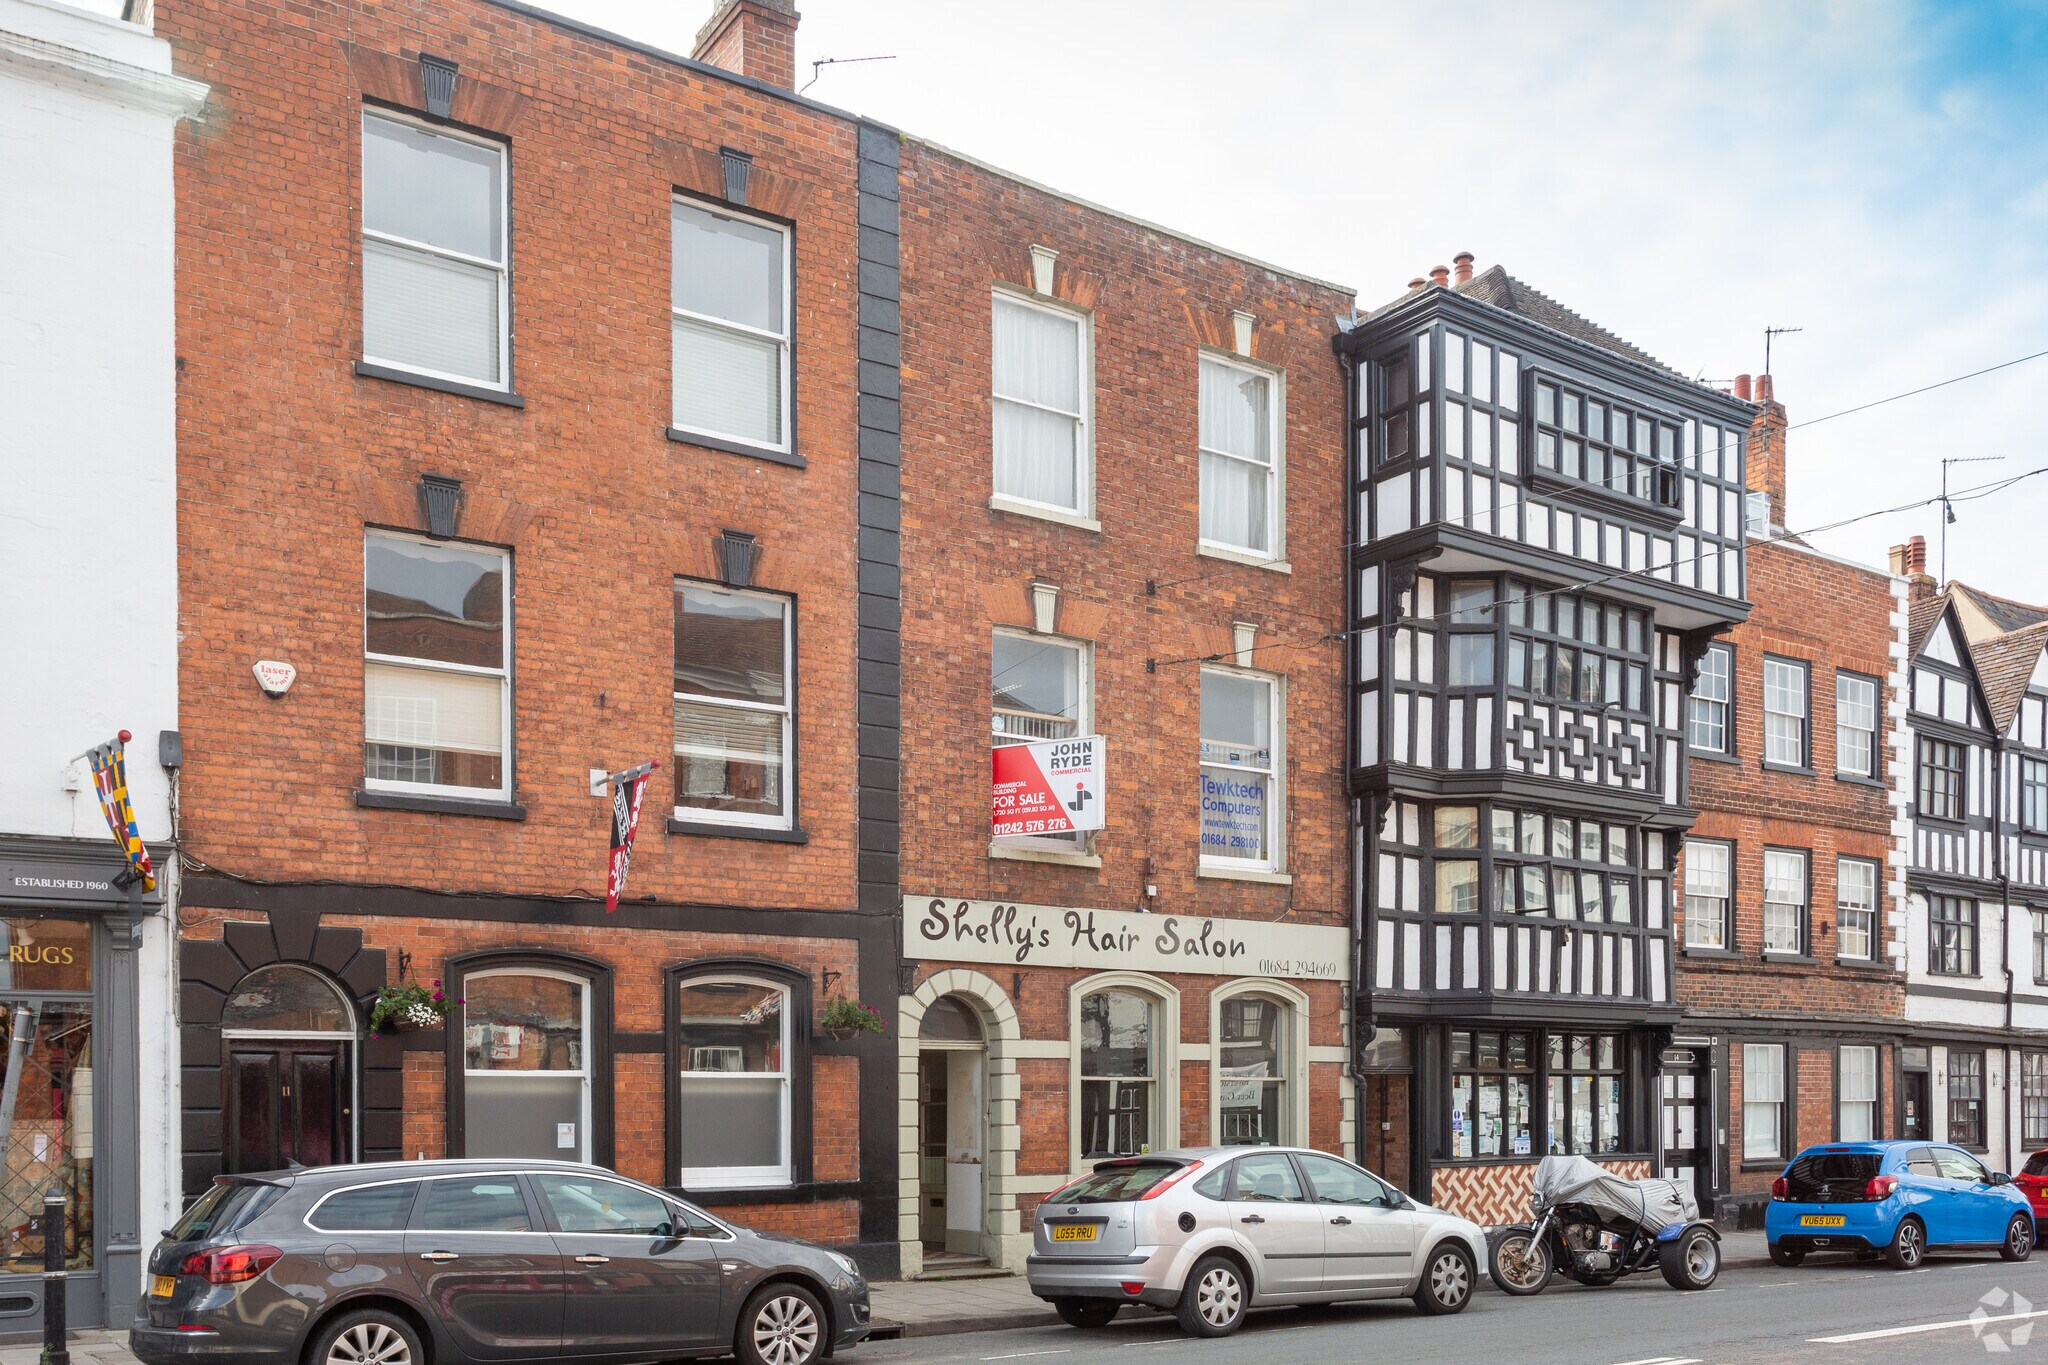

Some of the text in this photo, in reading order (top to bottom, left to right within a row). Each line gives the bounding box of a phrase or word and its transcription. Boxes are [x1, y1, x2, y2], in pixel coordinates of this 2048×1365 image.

[261, 665, 291, 675] laser
[263, 673, 289, 685] alarms
[1051, 741, 1092, 756] JOHN
[1051, 755, 1092, 769] RYDE
[1051, 767, 1092, 776] COMMERCIAL
[993, 781, 1027, 790] COMMERCIAL
[993, 788, 1017, 796] BUILDING
[1200, 774, 1264, 800] Tewktech
[993, 792, 1046, 808] FOR SALE
[1202, 797, 1261, 816] Computers
[993, 818, 1067, 835] 01242 576 276
[1204, 819, 1258, 832] www.tewktech.com
[1201, 833, 1260, 849] 01684 298100
[15, 877, 108, 890] ESTABLISHED 1960
[920, 899, 1245, 962] Shelly's Hair Salon
[9, 945, 74, 964] RUGS
[1259, 959, 1336, 977] 01684 294669
[1804, 1216, 1842, 1225] VU65 UXX
[1056, 1227, 1093, 1239] LG55 RRU
